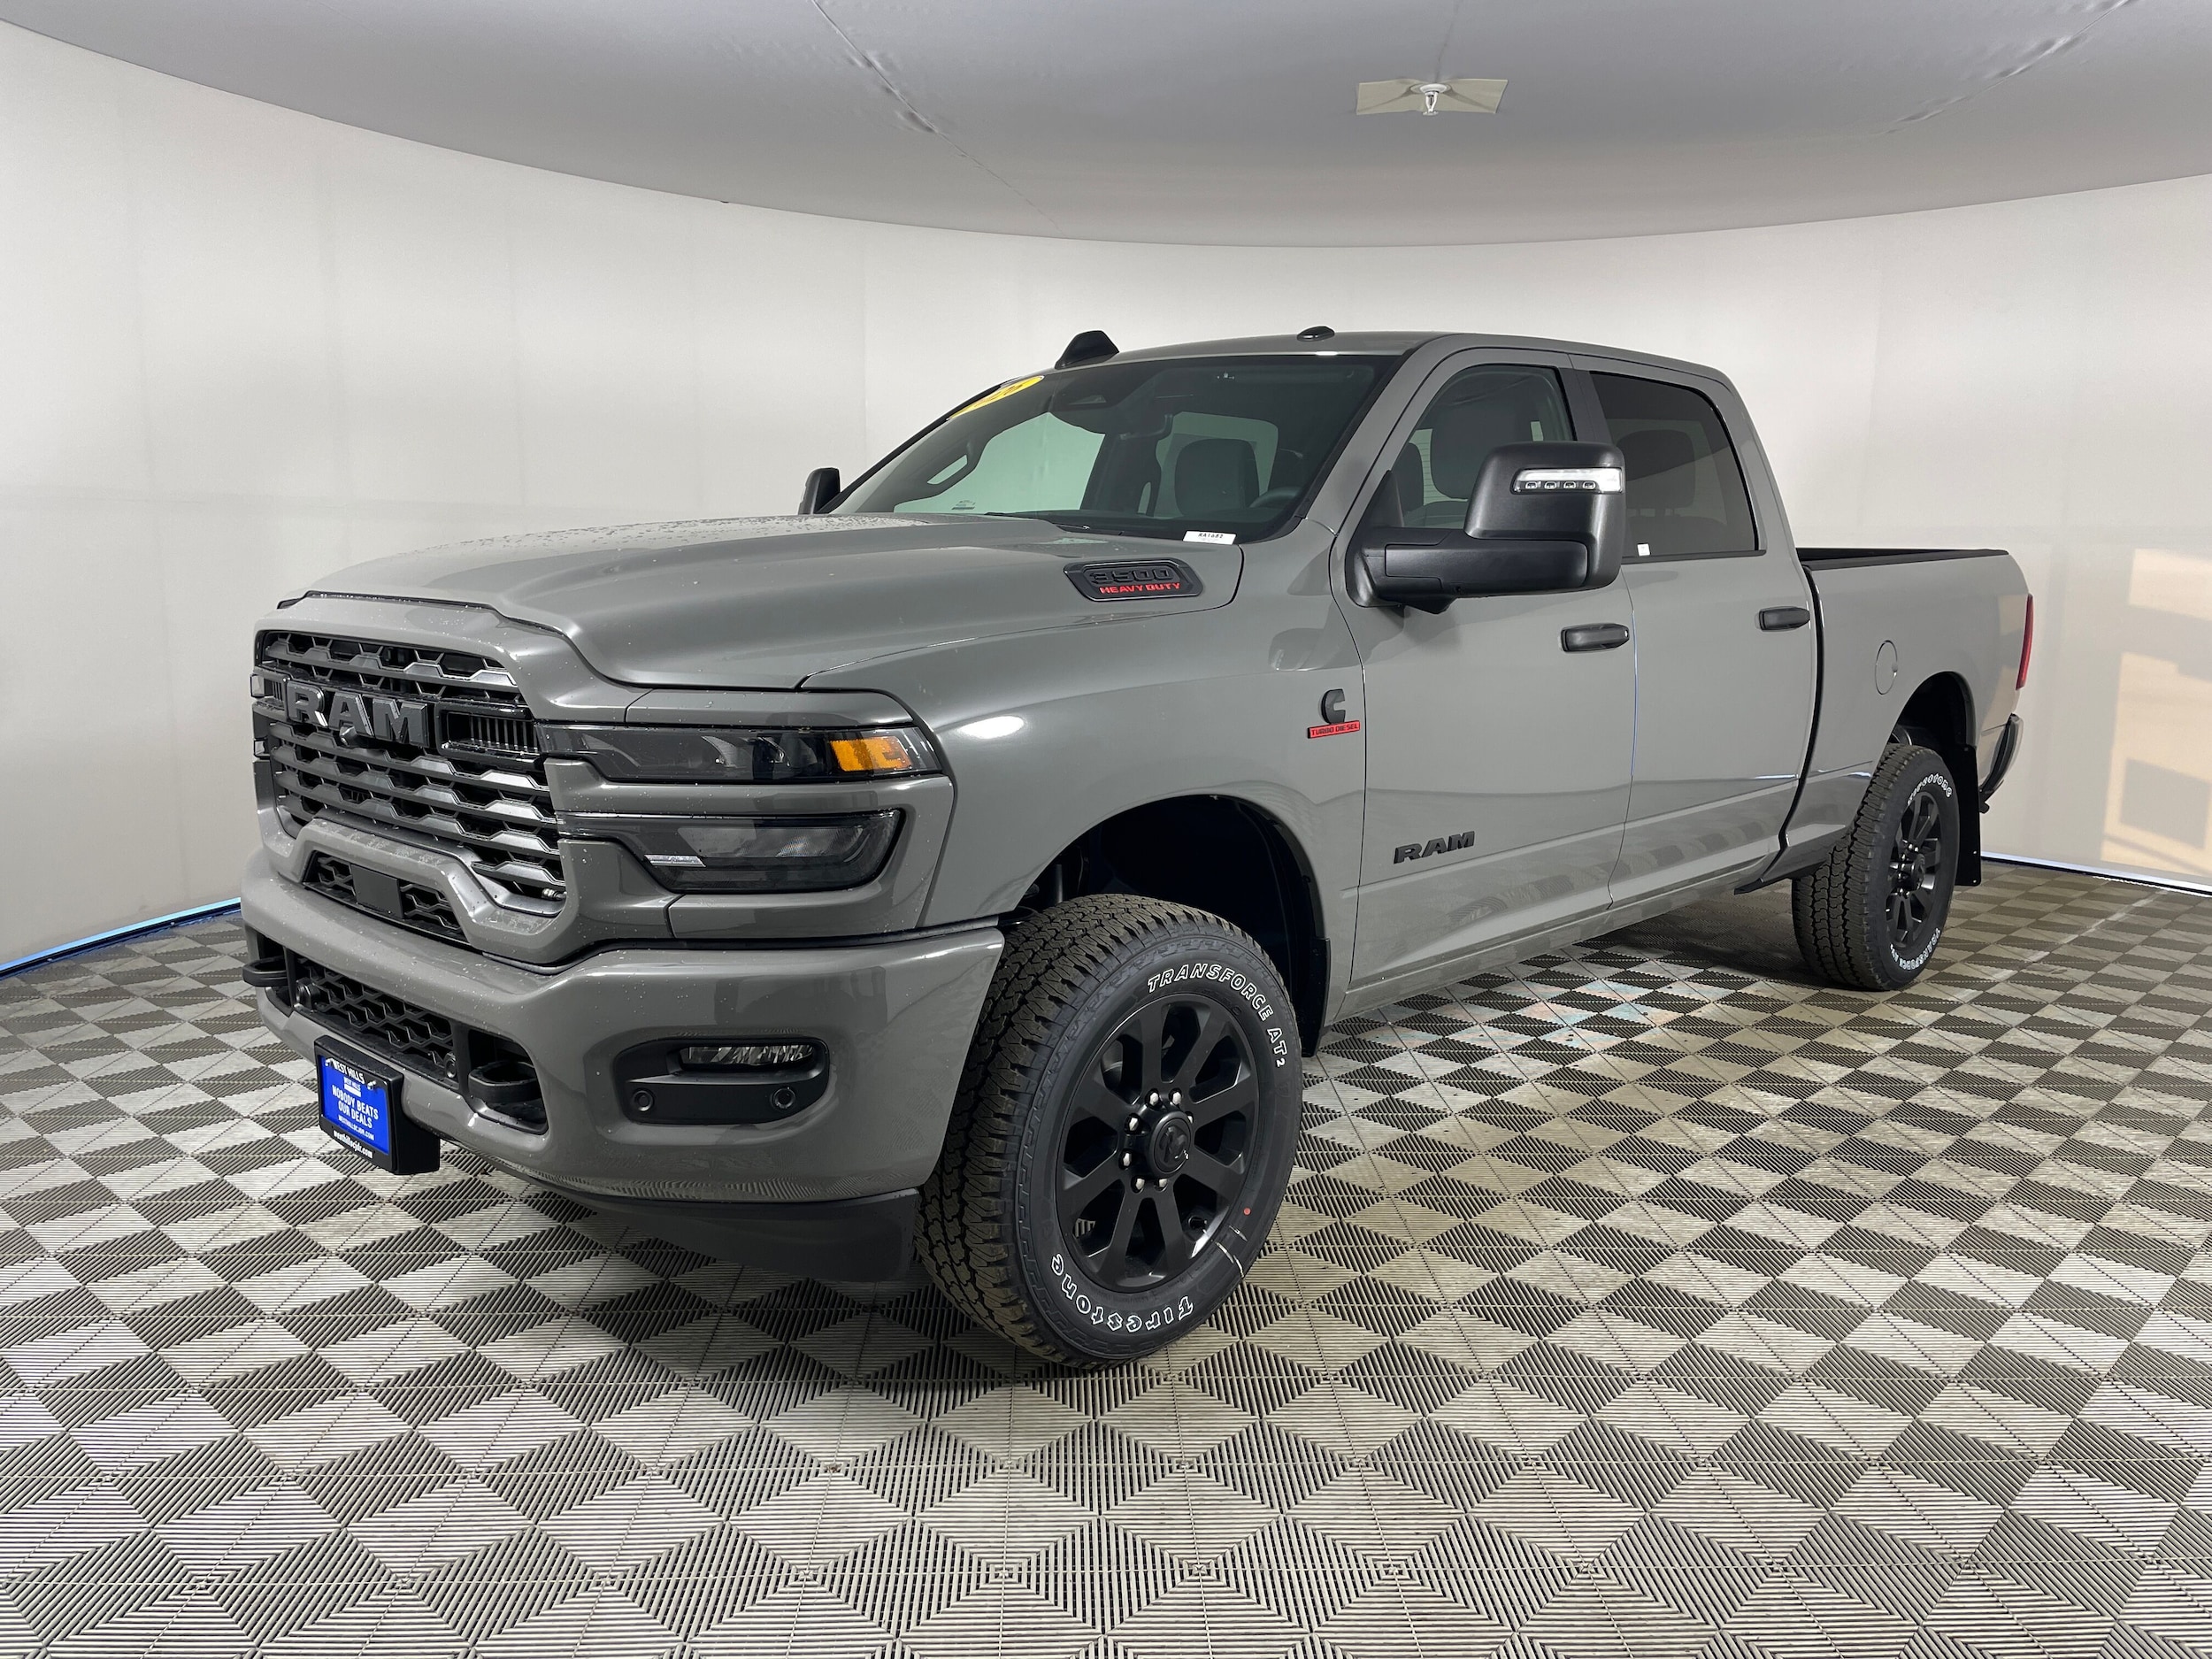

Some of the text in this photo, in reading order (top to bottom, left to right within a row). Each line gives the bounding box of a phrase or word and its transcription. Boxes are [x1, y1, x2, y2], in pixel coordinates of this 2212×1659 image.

[1090, 569, 1173, 584] 3500
[1100, 582, 1181, 595] HEAVY DUTY
[287, 680, 430, 749] RAM
[1311, 723, 1358, 736] TURBO DIESEL
[1394, 830, 1475, 864] RAM
[1148, 963, 1274, 1022] TRANSFORCE
[332, 1058, 347, 1075] WEST
[332, 1085, 356, 1109] NOBODY
[357, 1099, 379, 1120] BEATS
[338, 1100, 373, 1129] OUR DEALS
[1051, 1253, 1194, 1333] Firestone
